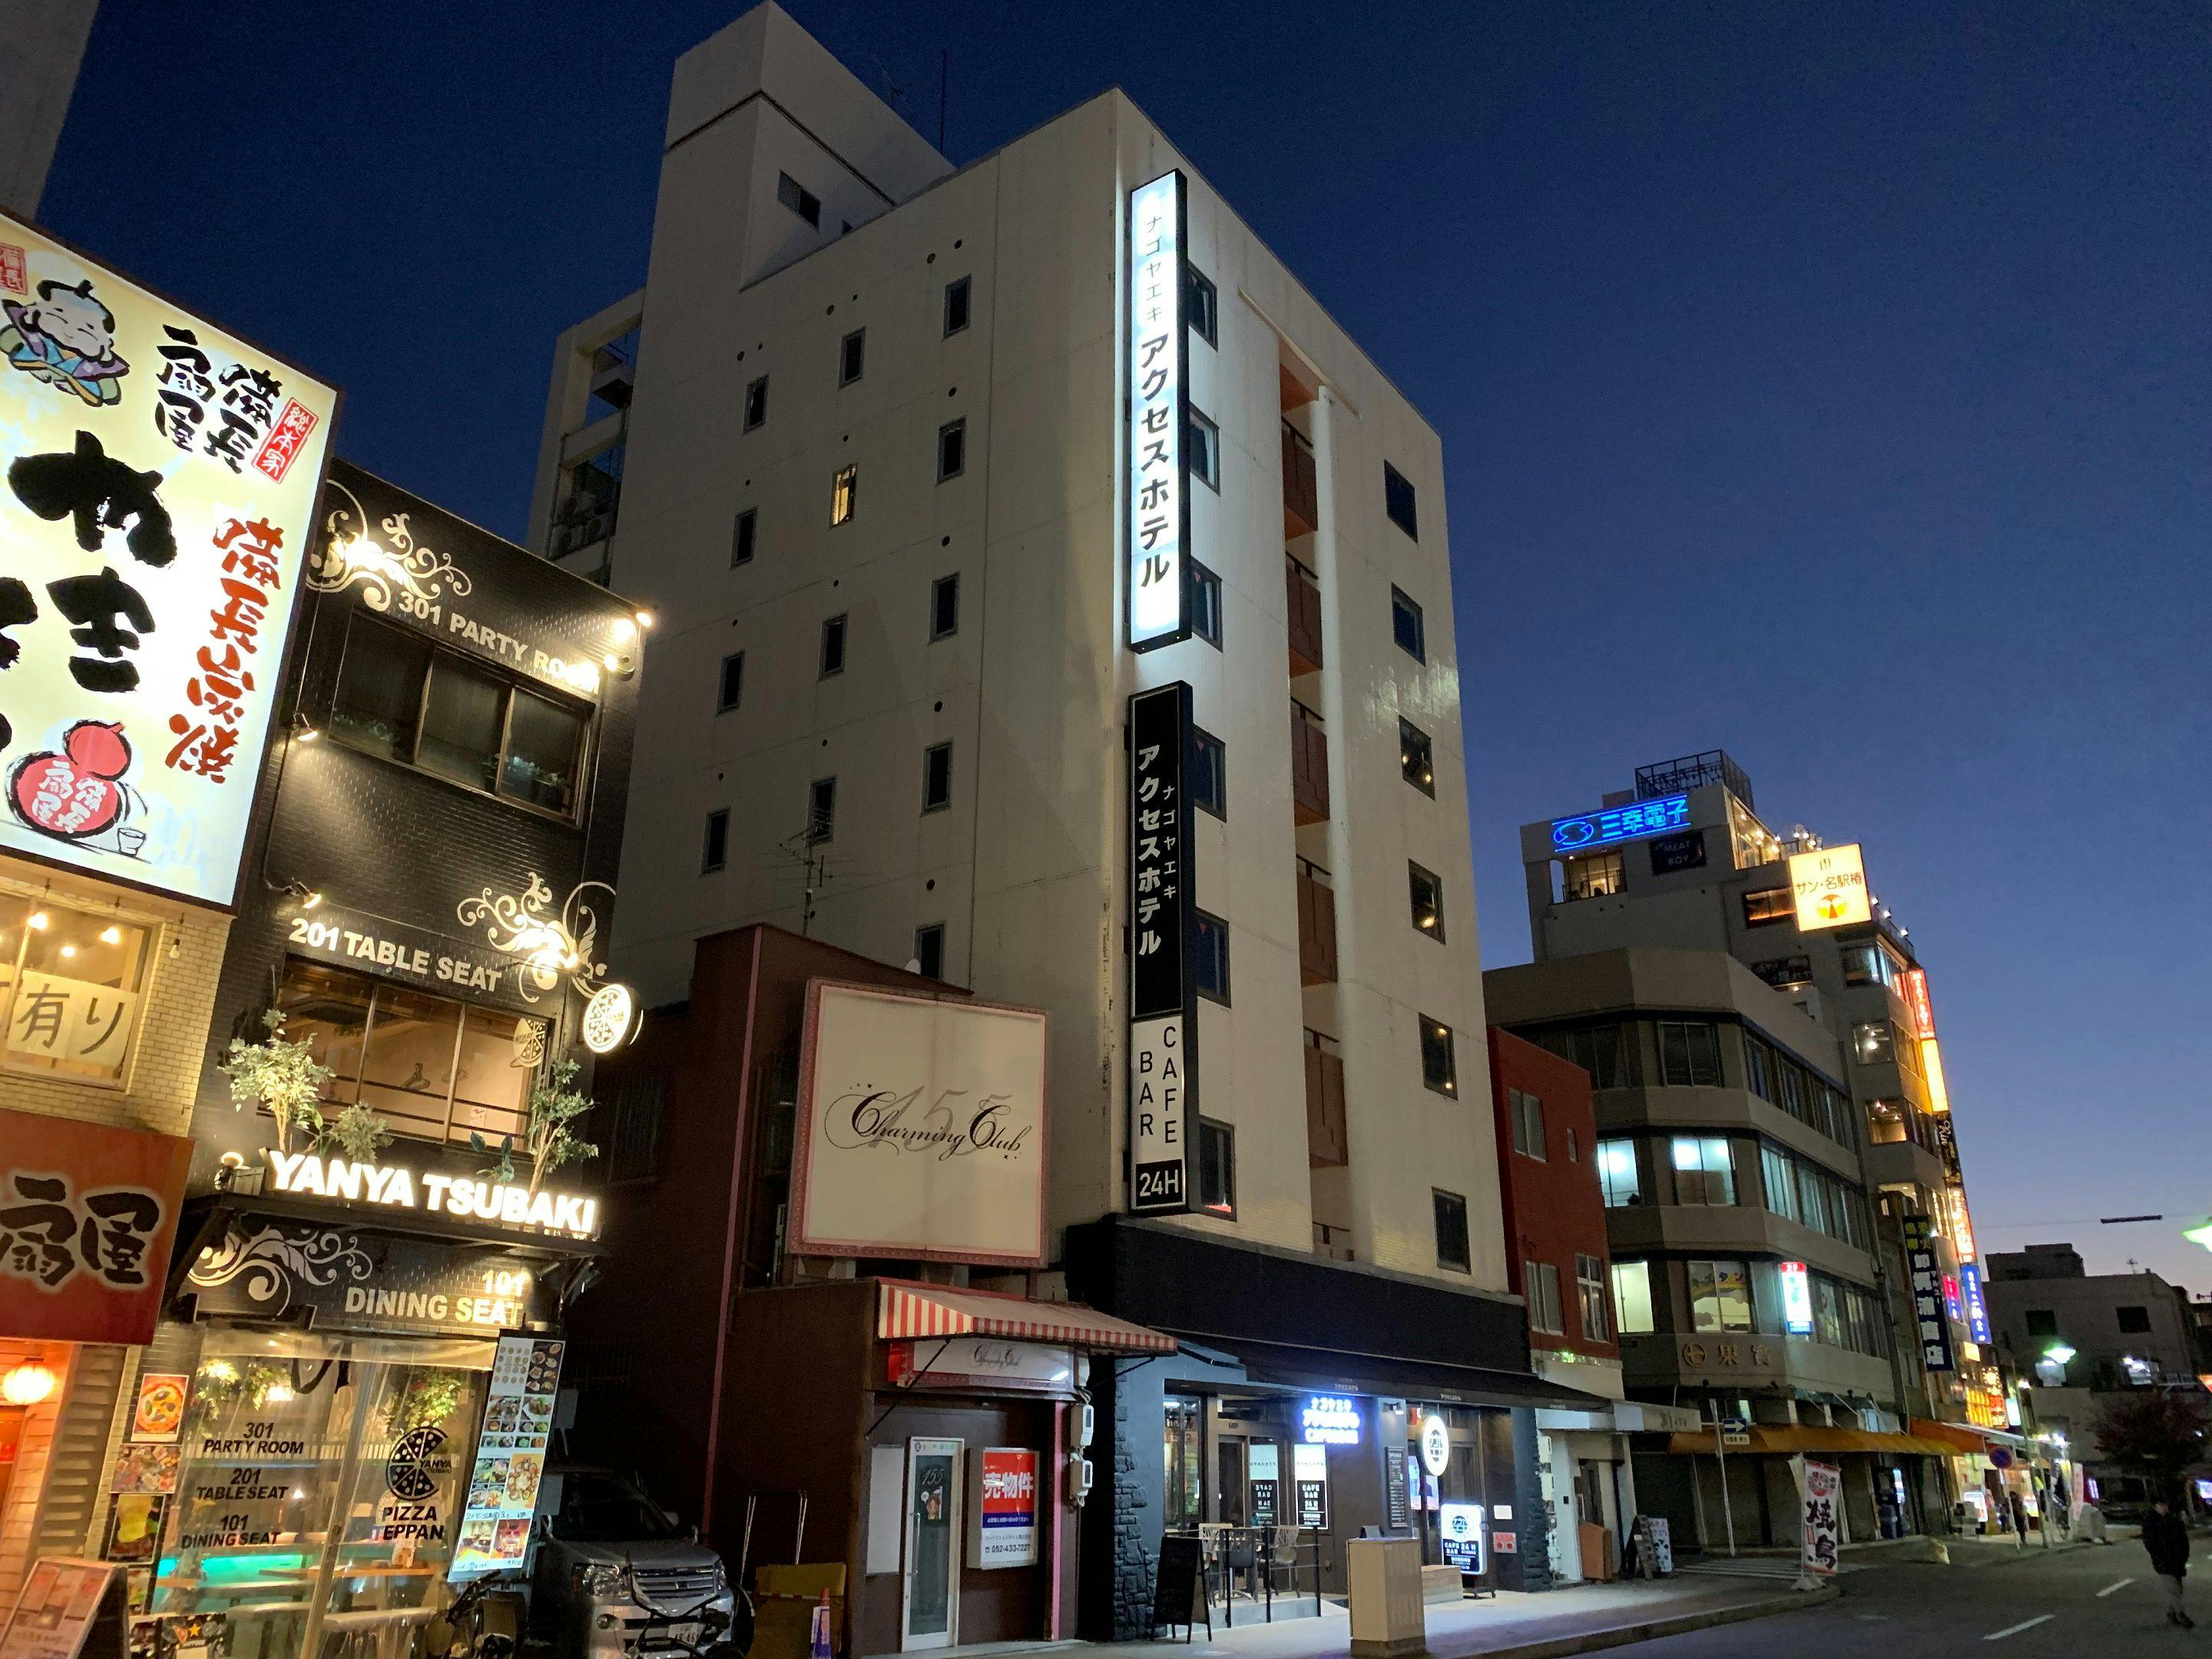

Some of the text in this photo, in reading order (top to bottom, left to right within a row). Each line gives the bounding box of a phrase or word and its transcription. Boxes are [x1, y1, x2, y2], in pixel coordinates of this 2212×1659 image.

[1140, 215, 1170, 589] ナゴヤエキ アクセスホテル
[399, 591, 601, 695] 301 PARTY RO
[1600, 800, 1689, 839] 三幸電子
[1137, 743, 1161, 956] アクセスホテル
[1162, 786, 1177, 899] ナゴヤエキ
[289, 917, 502, 993] 201 TABLE SEAT
[1140, 1051, 1154, 1137] BAR
[1162, 1026, 1177, 1144] CAFE
[825, 1089, 1031, 1161] Charming Club
[269, 1150, 598, 1234] YANYA TSUBAKI
[1139, 1171, 1180, 1198] 24H
[482, 1270, 530, 1297] 101
[345, 1286, 524, 1327] DINING SEAT
[203, 1439, 305, 1455] PARTY ROOM
[242, 1422, 275, 1439] 301
[196, 1485, 289, 1501] TABLE SEAT
[230, 1467, 263, 1485] 201
[985, 1471, 1034, 1498] 売物件
[220, 1514, 249, 1532] 101
[382, 1505, 438, 1522] PIZZA
[180, 1532, 281, 1550] DINING SEAT
